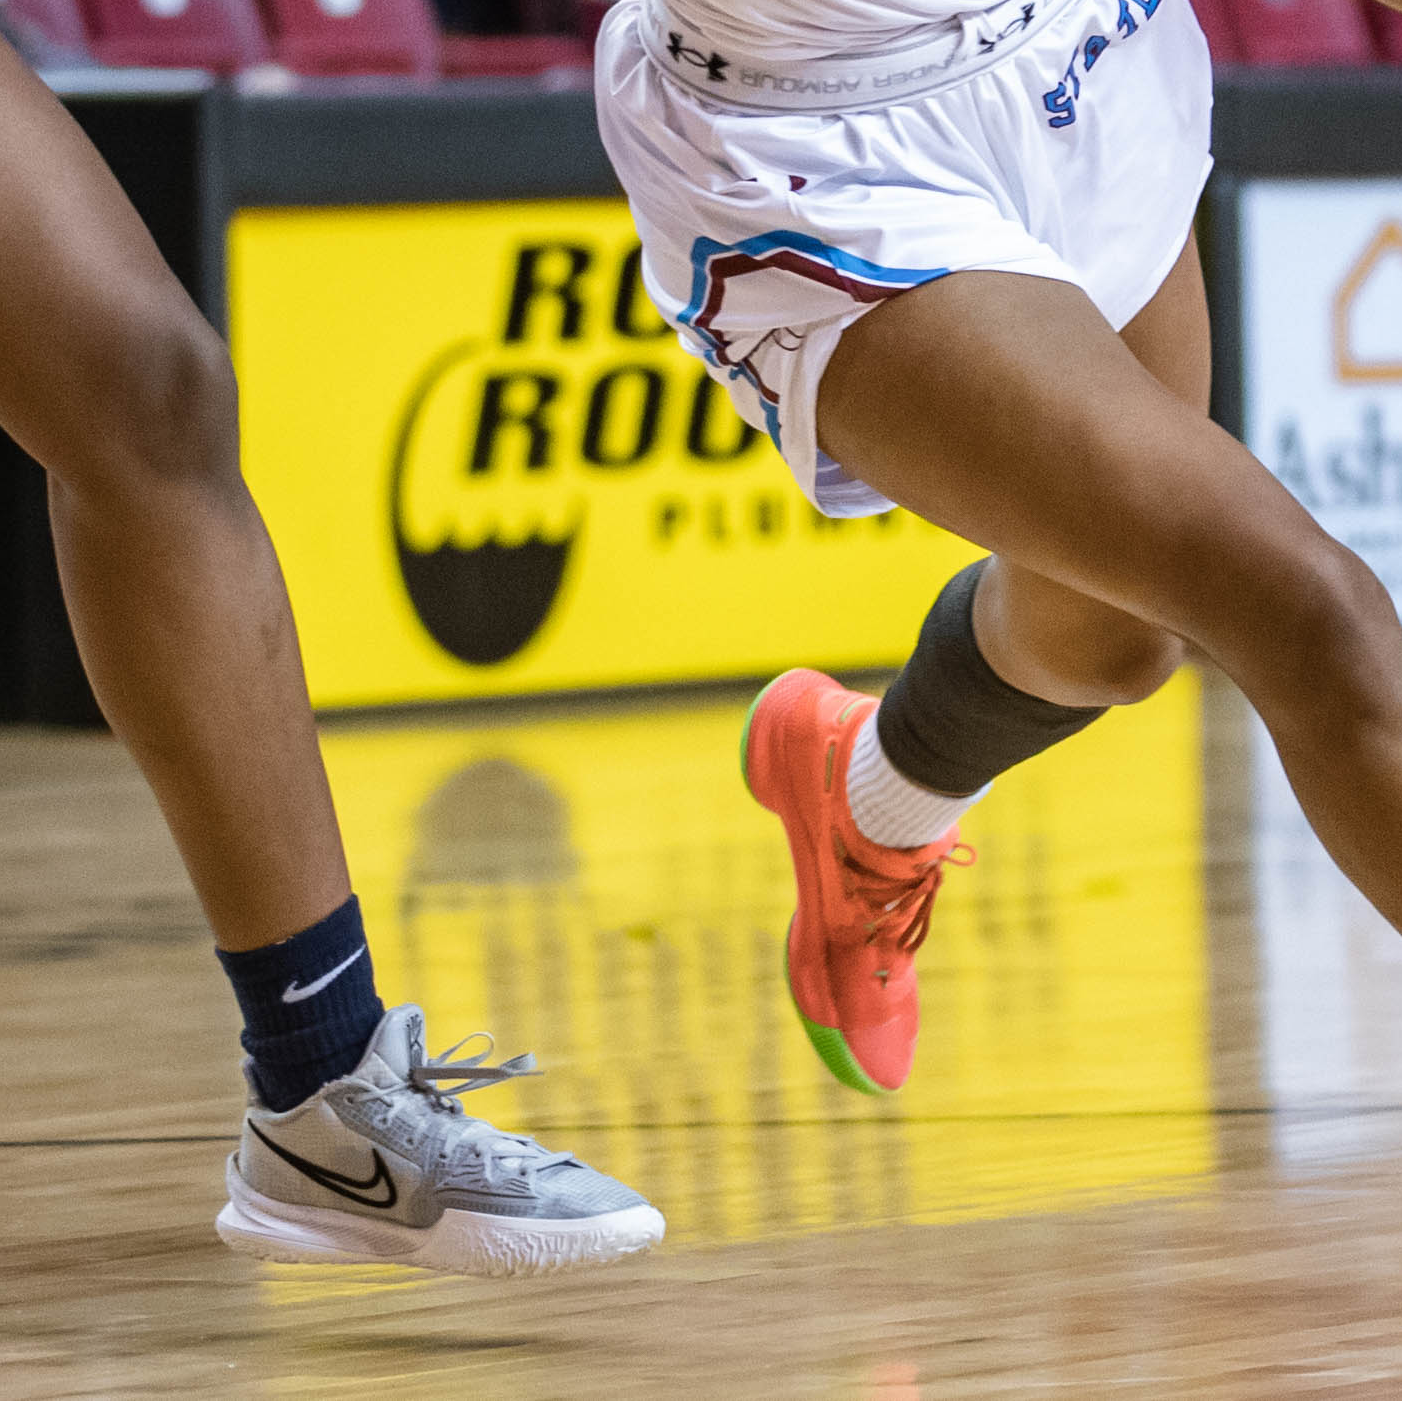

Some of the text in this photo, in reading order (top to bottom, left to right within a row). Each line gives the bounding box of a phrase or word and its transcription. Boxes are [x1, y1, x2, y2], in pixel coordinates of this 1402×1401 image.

[737, 68, 862, 95] ARMOUR
[500, 240, 678, 346] RO
[465, 363, 761, 478] ROO
